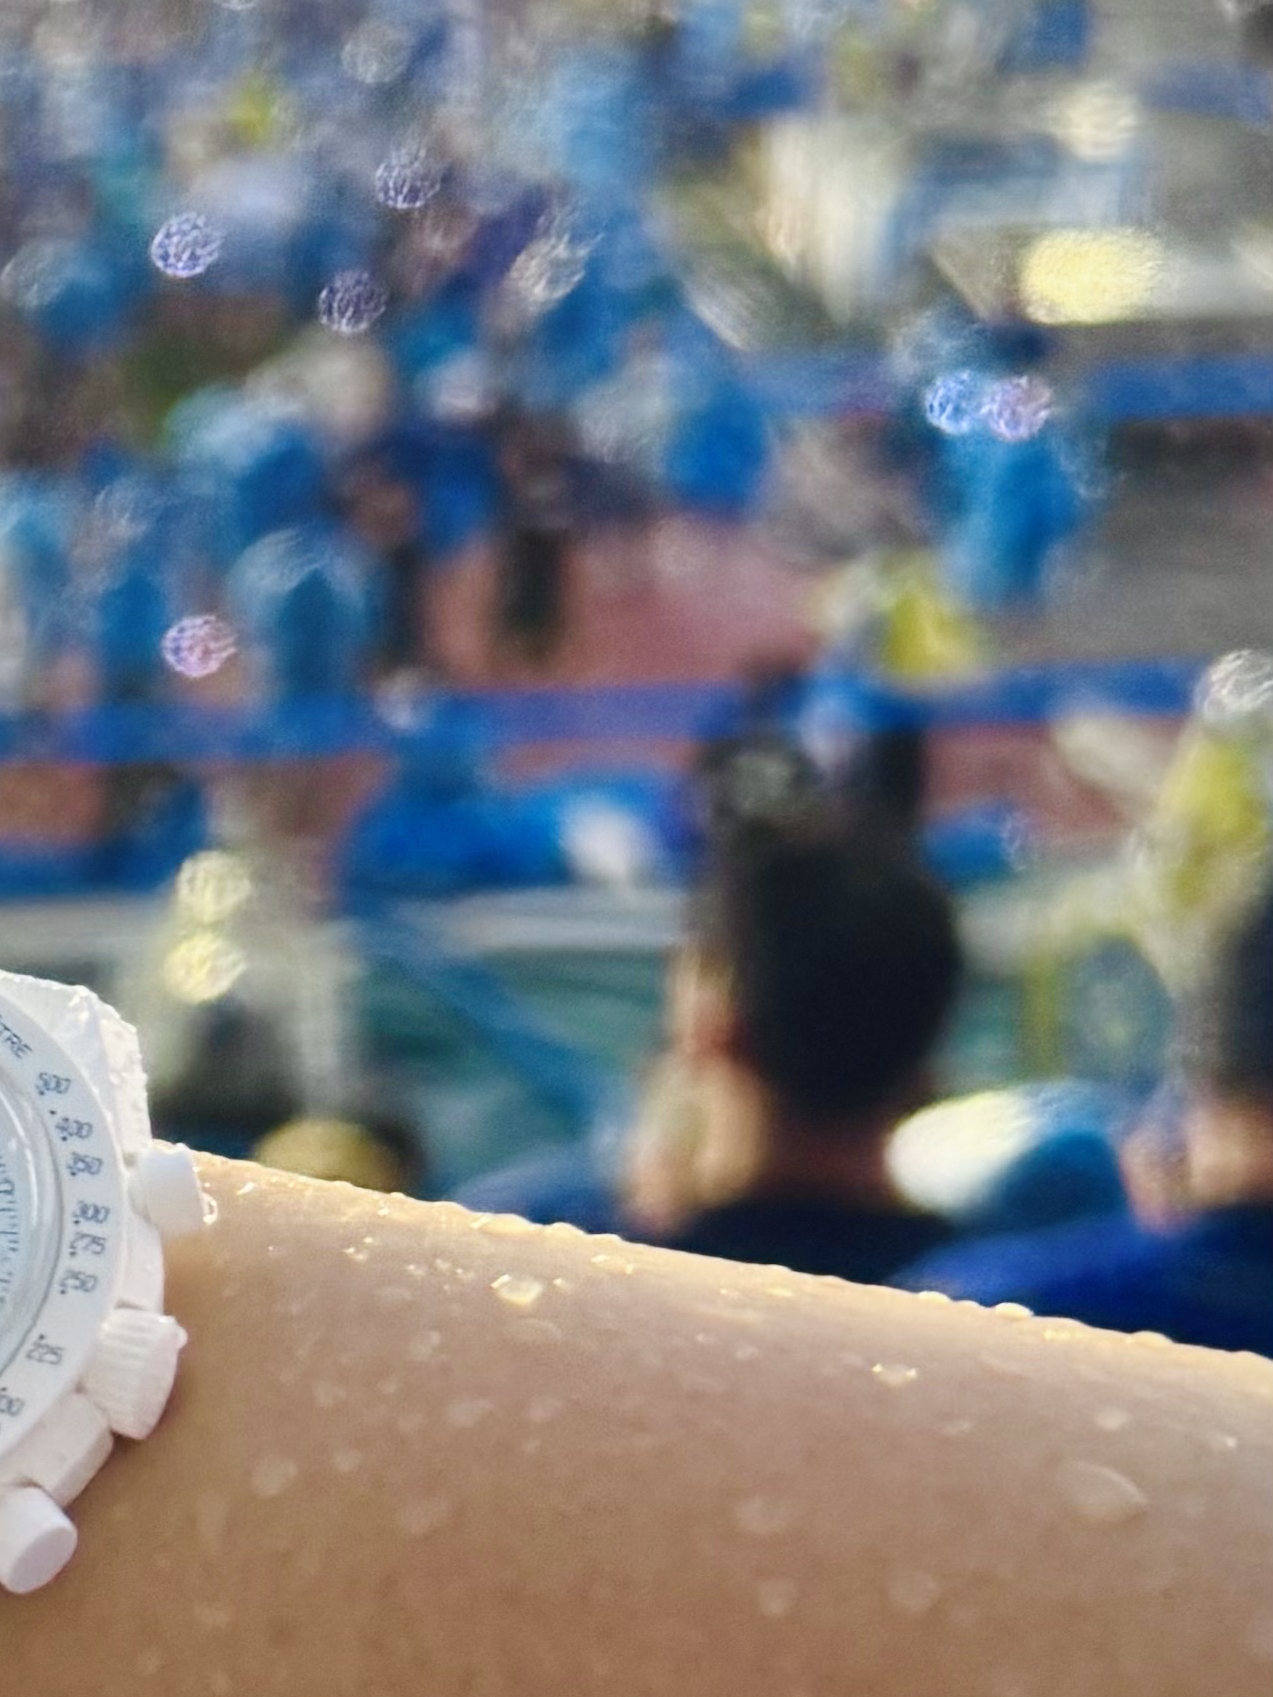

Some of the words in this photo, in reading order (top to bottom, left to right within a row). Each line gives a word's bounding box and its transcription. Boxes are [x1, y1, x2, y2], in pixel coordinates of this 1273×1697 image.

[35, 1072, 72, 1095] 500
[67, 1153, 103, 1175] 350
[73, 1201, 110, 1223] 300
[70, 1232, 107, 1255] 275
[59, 1270, 98, 1293] 250
[25, 1341, 66, 1366] 225
